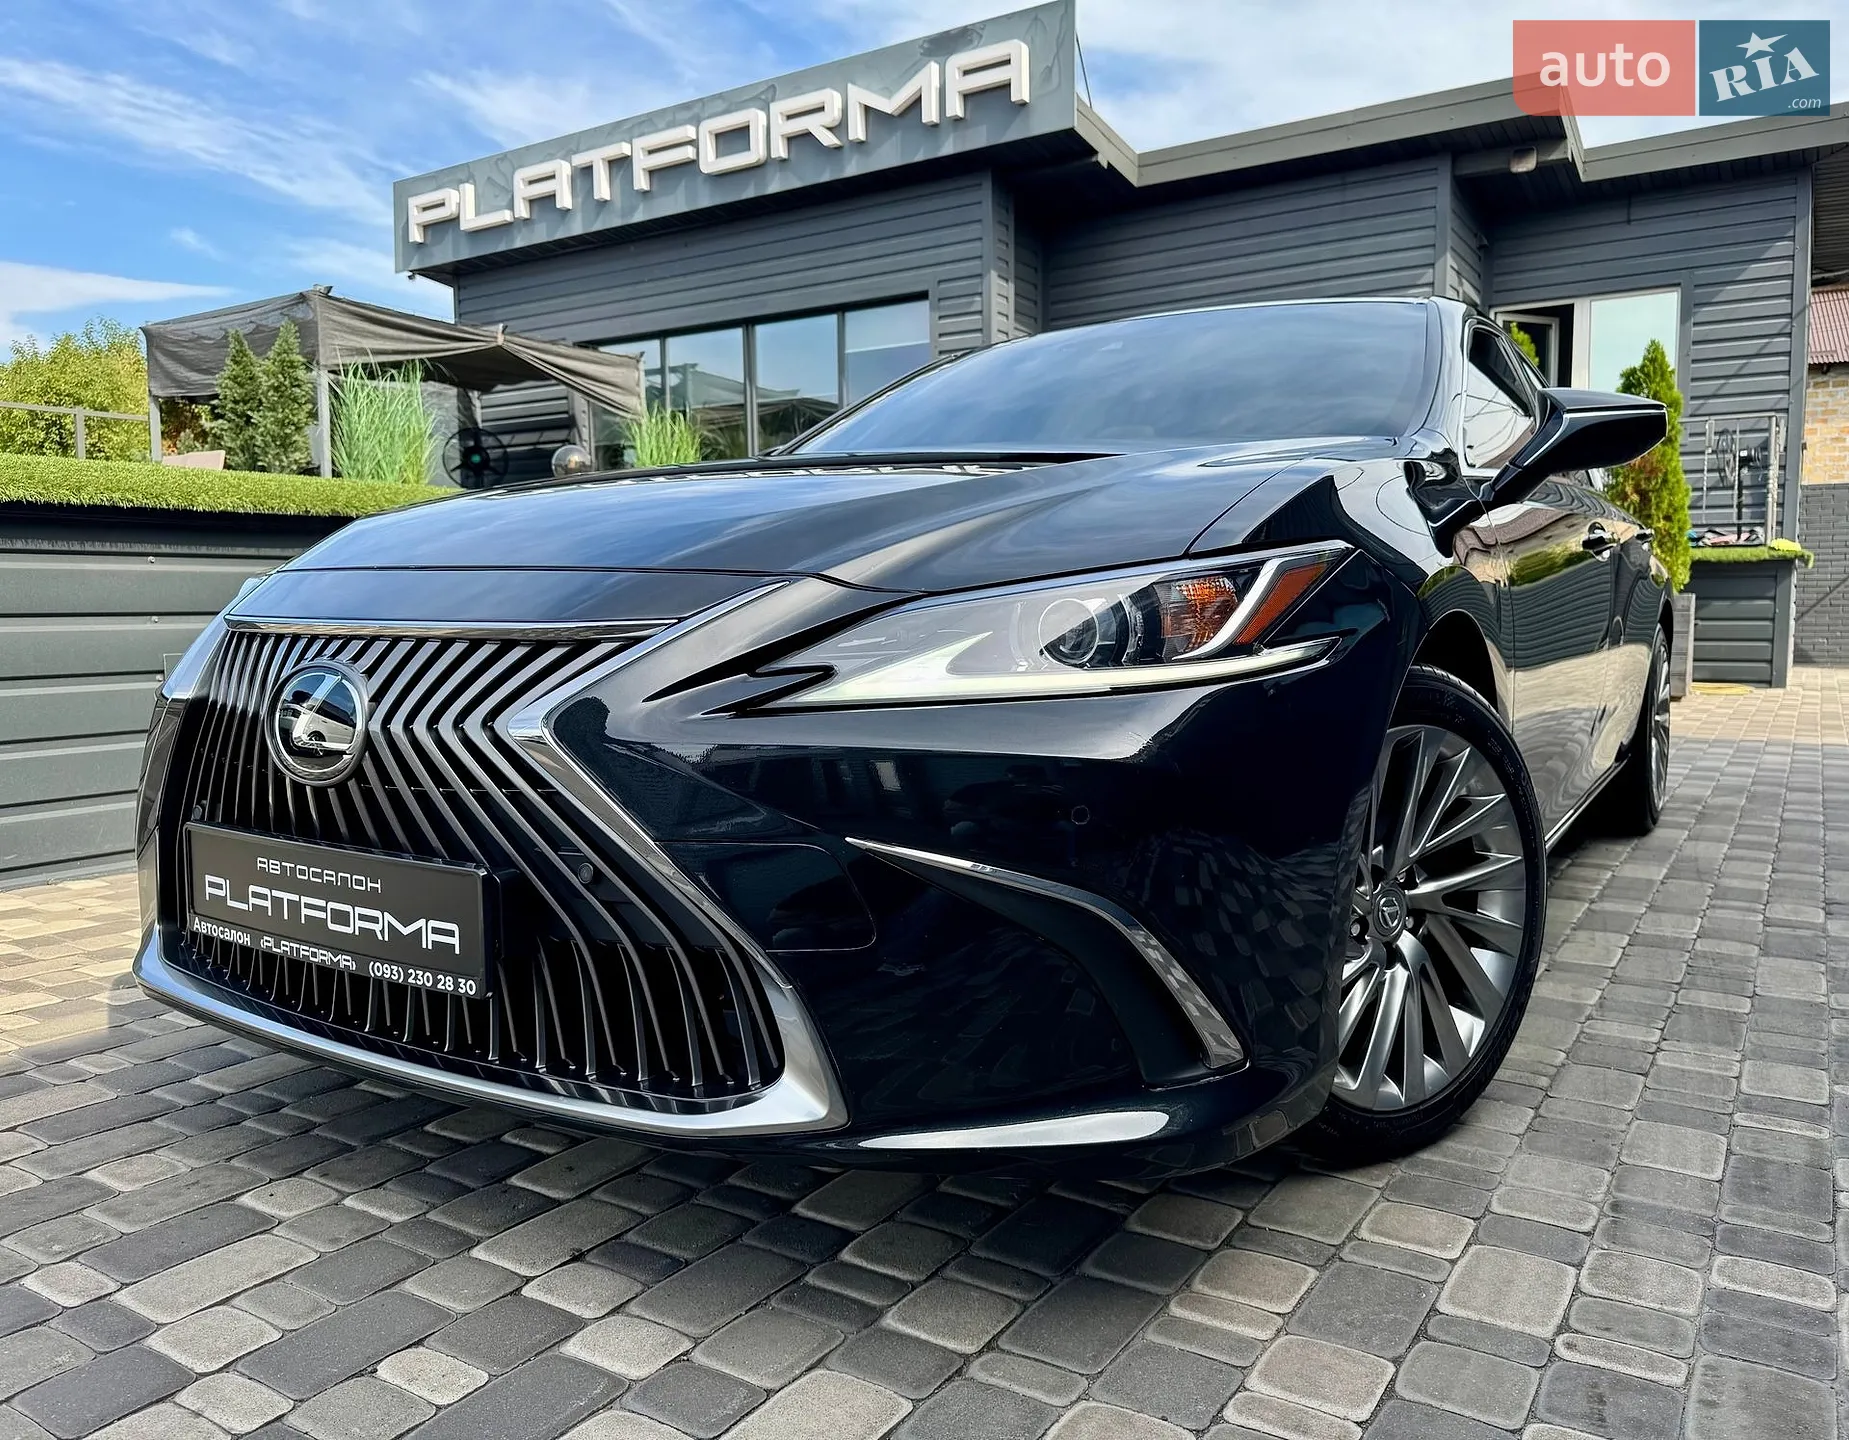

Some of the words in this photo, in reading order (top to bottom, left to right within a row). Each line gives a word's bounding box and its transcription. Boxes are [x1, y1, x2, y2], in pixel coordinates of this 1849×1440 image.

[407, 38, 1031, 244] PLATFORMA
[204, 874, 460, 955] PLATFORMA
[256, 856, 382, 893] АВТОСАЛОН
[193, 916, 251, 946] Автосалон
[368, 960, 404, 984] (093)
[407, 968, 433, 987] 230
[436, 974, 454, 991] 28
[457, 978, 477, 996] 30
